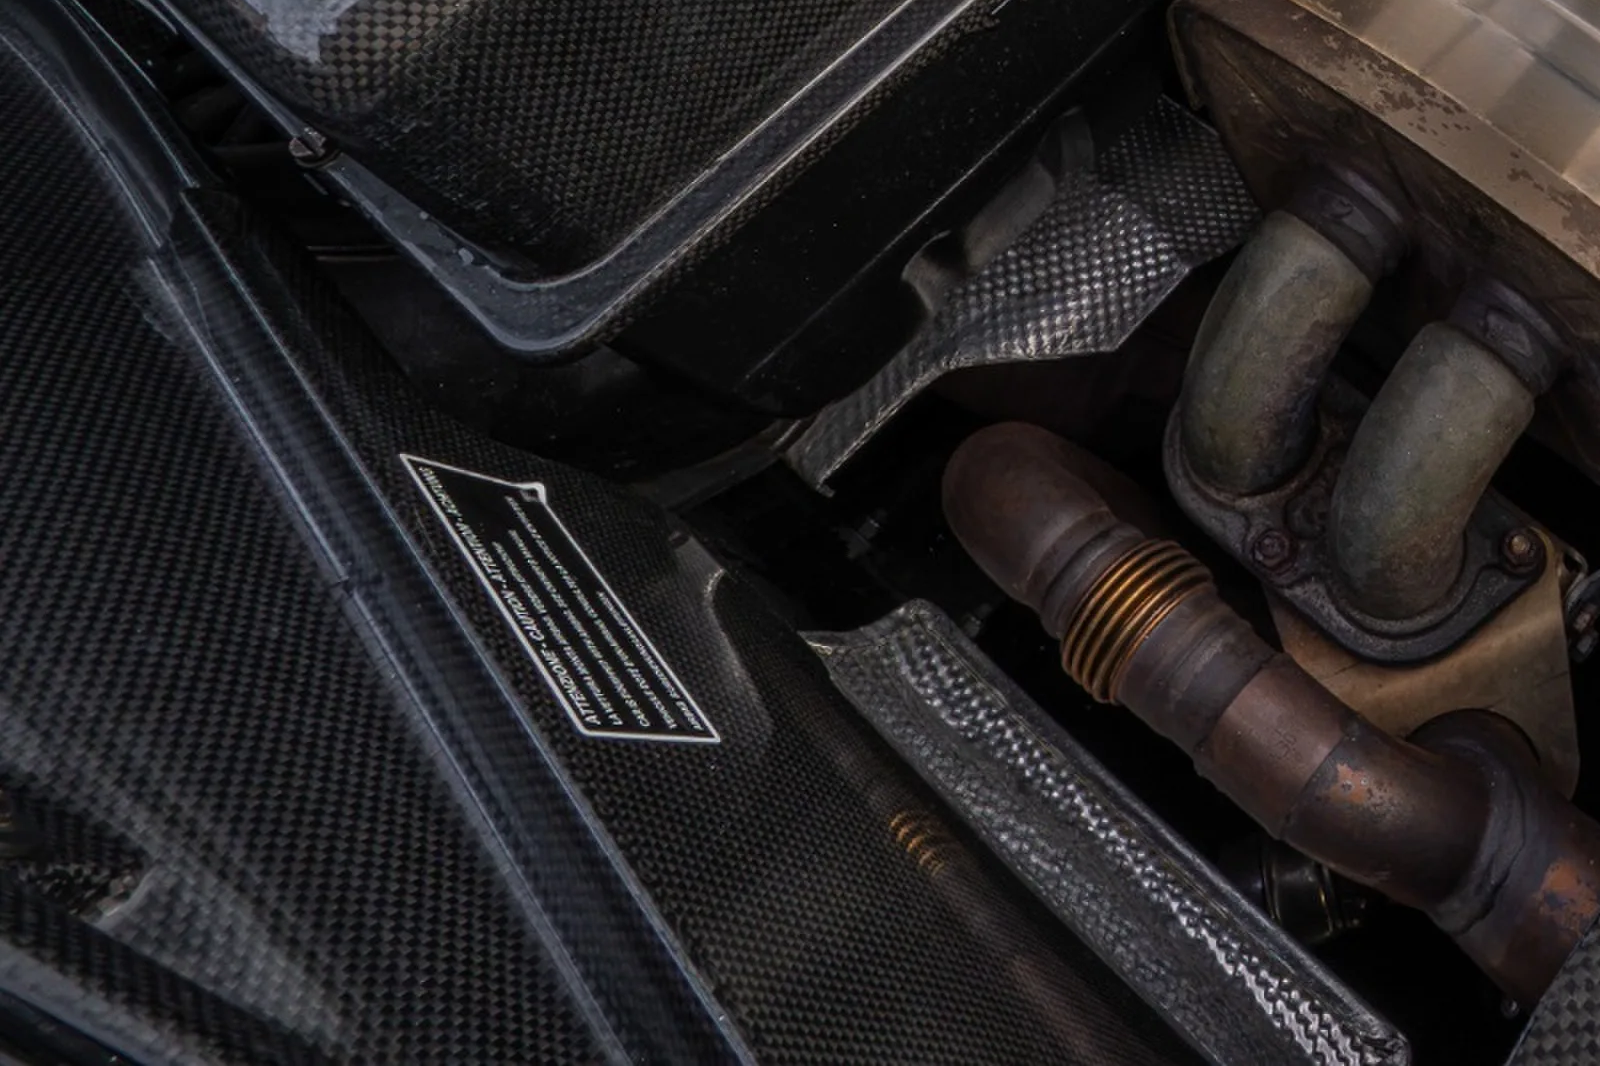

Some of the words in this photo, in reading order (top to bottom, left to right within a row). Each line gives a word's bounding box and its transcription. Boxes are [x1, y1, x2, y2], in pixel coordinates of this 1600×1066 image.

[456, 521, 507, 582] ATTENTION
[501, 588, 547, 641] CAUTION
[540, 648, 602, 724] ATTENZIONE
